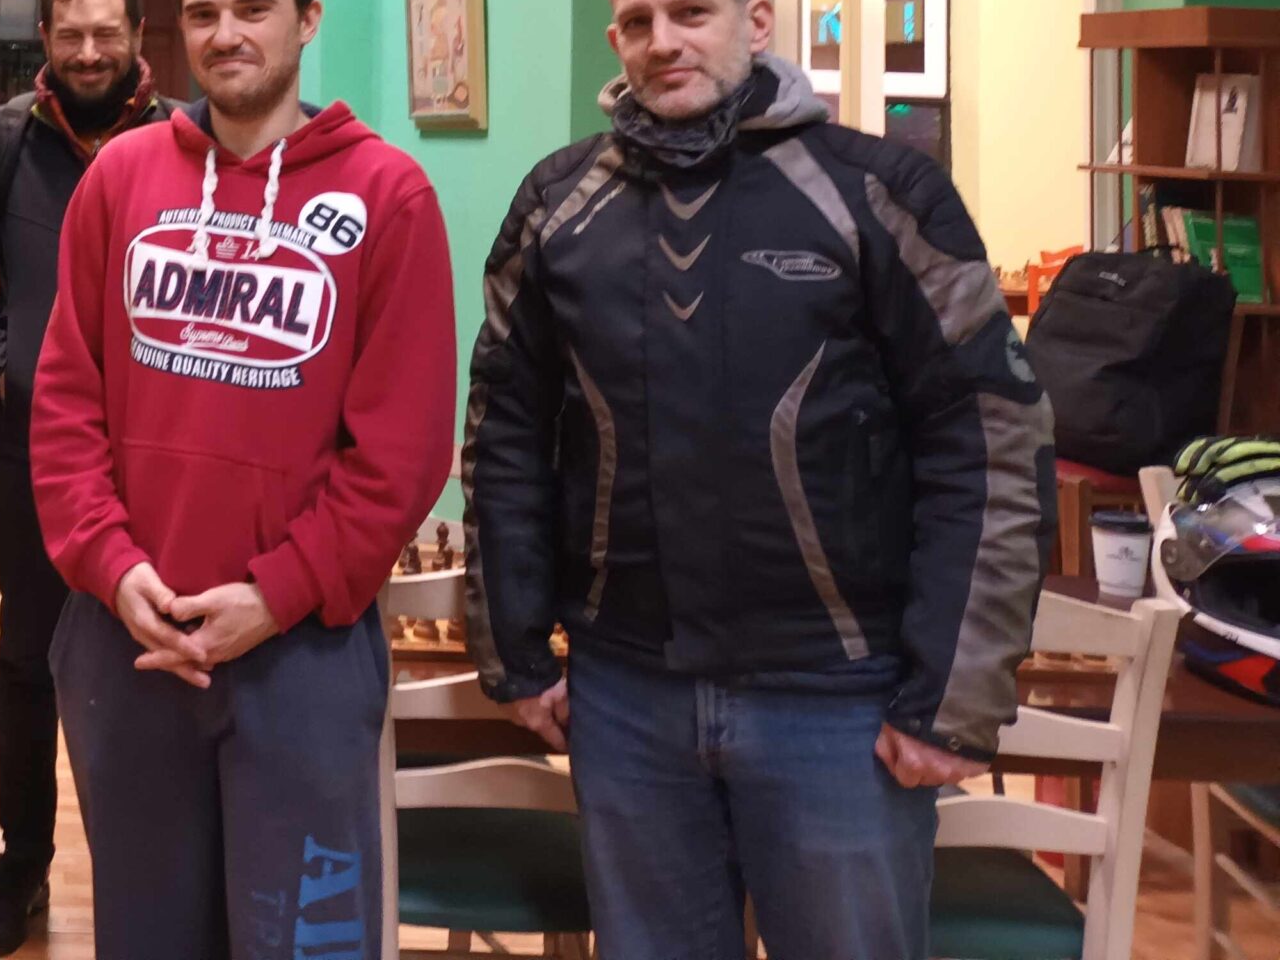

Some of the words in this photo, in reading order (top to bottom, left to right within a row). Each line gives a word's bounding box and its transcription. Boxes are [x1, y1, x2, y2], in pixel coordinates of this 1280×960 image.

[158, 208, 208, 225] AUTHENT
[211, 211, 256, 231] PRODUCT
[305, 202, 363, 249] 86
[132, 259, 309, 337] ADMIRAL
[171, 355, 231, 382] QUALITY
[231, 366, 302, 388] HERITAGE
